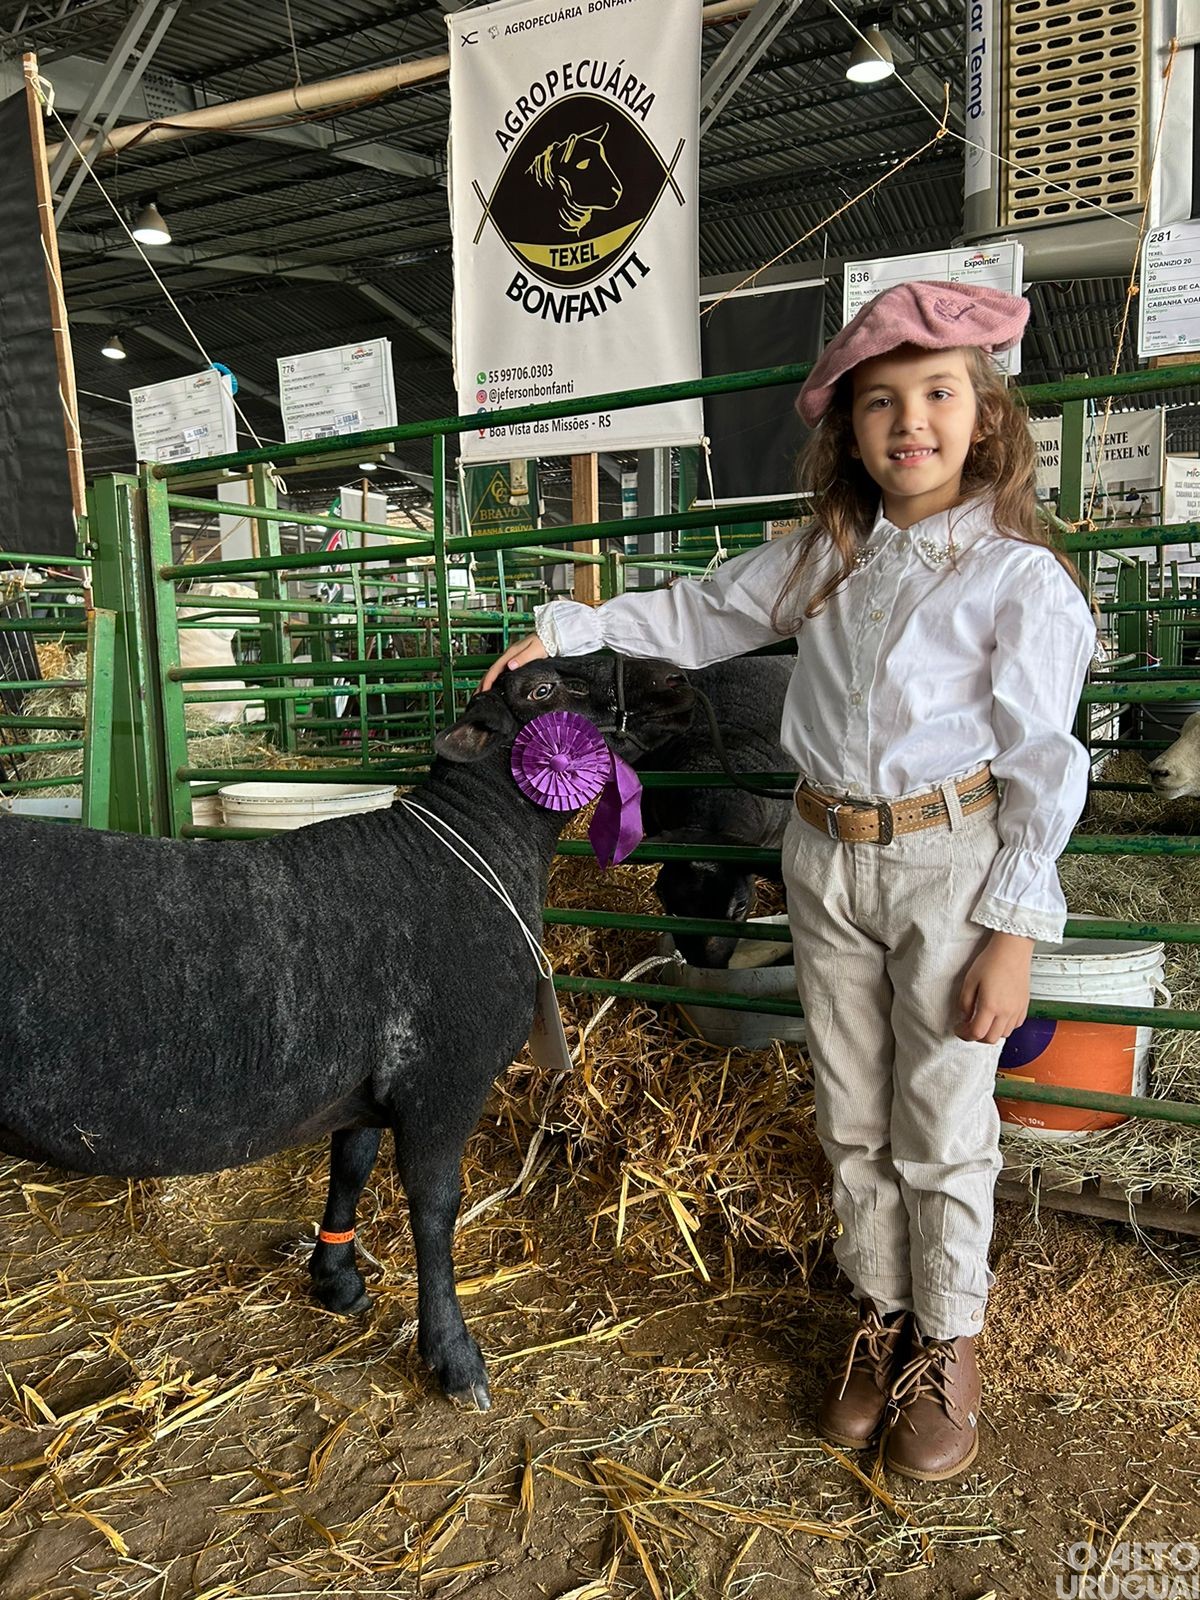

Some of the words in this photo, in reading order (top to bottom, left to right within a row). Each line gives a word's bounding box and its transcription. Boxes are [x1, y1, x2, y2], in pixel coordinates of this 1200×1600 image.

[504, 6, 583, 35] AGROPECUÁRIA
[971, 0, 983, 32] ar
[967, 37, 985, 119] Temp
[494, 59, 656, 153] AGROPECUÁRIA
[1150, 230, 1171, 243] 281
[549, 242, 600, 267] TEXEL
[1149, 259, 1182, 269] VOANIZIO
[505, 250, 651, 323] BONFANTI
[850, 272, 869, 283] 836
[1148, 285, 1177, 294] MATEUS
[1147, 299, 1182, 308] CABANHA
[282, 364, 295, 374] 776
[488, 370, 499, 384] 55
[500, 364, 553, 383] 99706.0303
[489, 380, 574, 404] @jefersonbonfanti
[490, 427, 506, 437] Boa
[508, 423, 531, 436] Vista
[534, 420, 549, 434] das
[551, 417, 589, 432] Missões
[598, 414, 611, 428] RS
[1034, 440, 1060, 452] ENDA
[1104, 447, 1134, 461] TEXEL
[1137, 444, 1150, 457] NC
[479, 506, 520, 521] BRAVO
